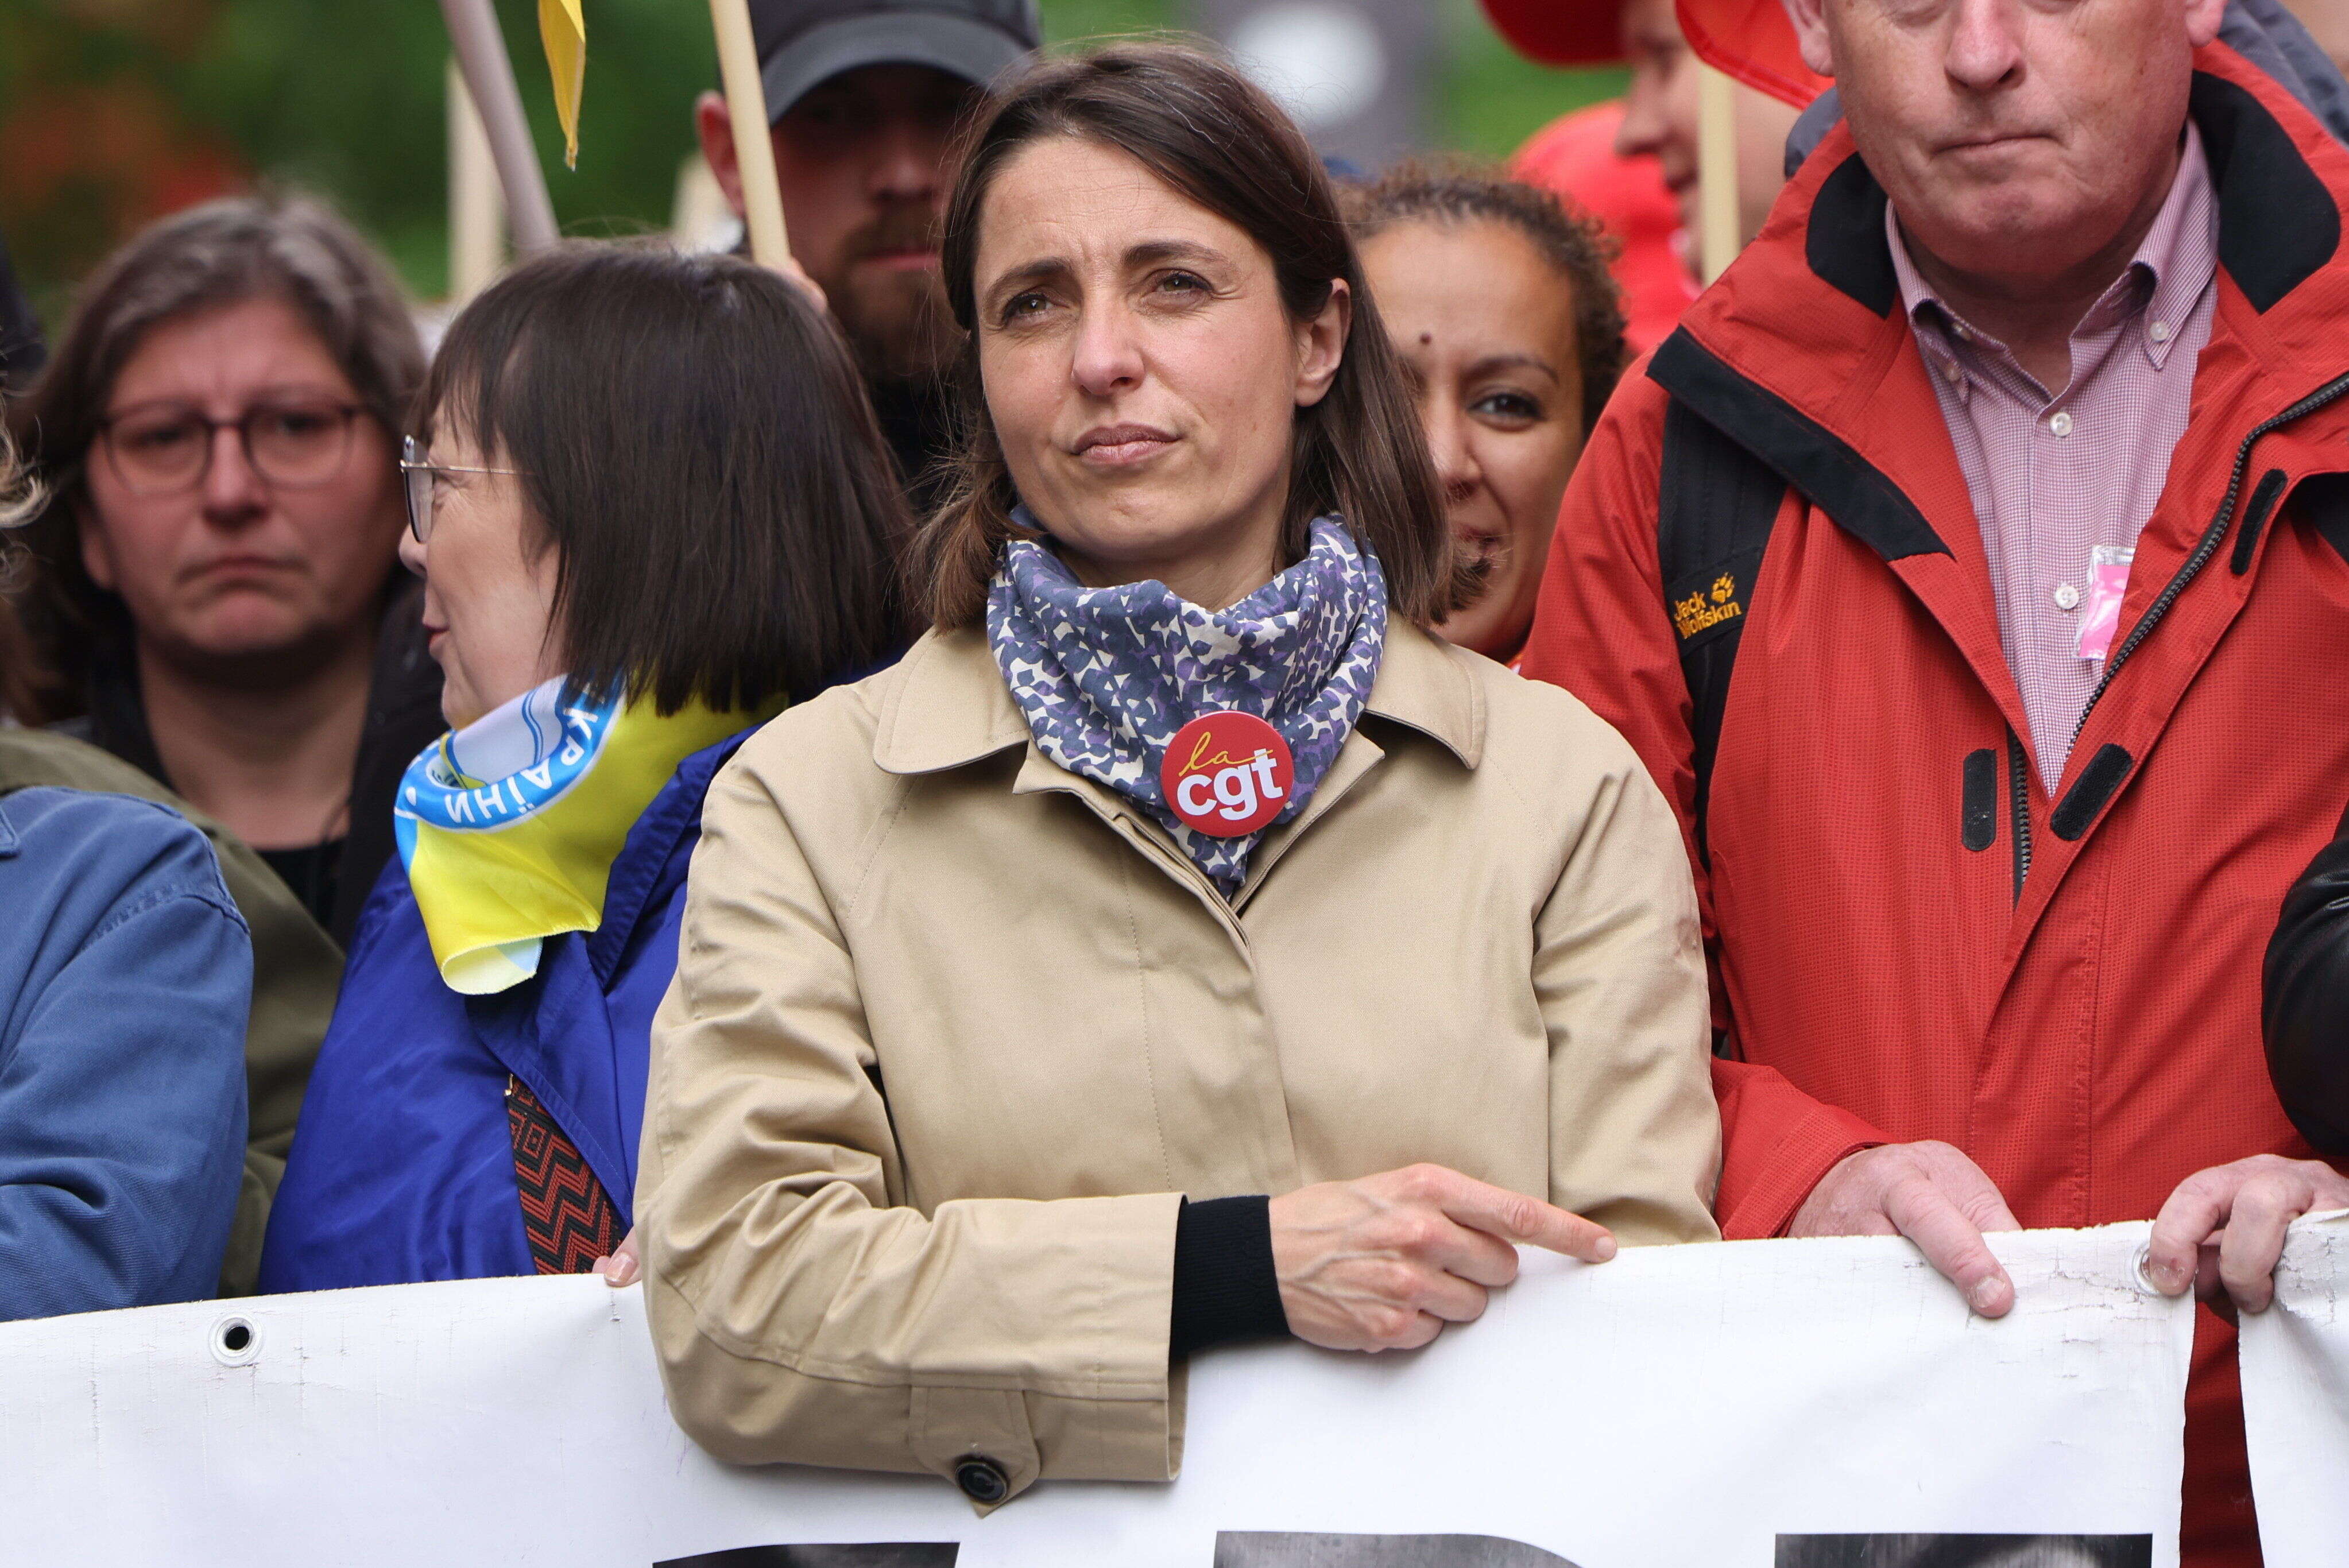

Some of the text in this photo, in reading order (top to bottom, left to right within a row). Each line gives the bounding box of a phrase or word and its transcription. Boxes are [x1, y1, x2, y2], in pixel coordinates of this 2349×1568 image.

[1673, 591, 1706, 622] Jack
[1676, 601, 1742, 639] Wolfskin
[444, 681, 606, 823] КРАЇНИ
[1178, 731, 1274, 777] la
[1177, 748, 1283, 821] cgt
